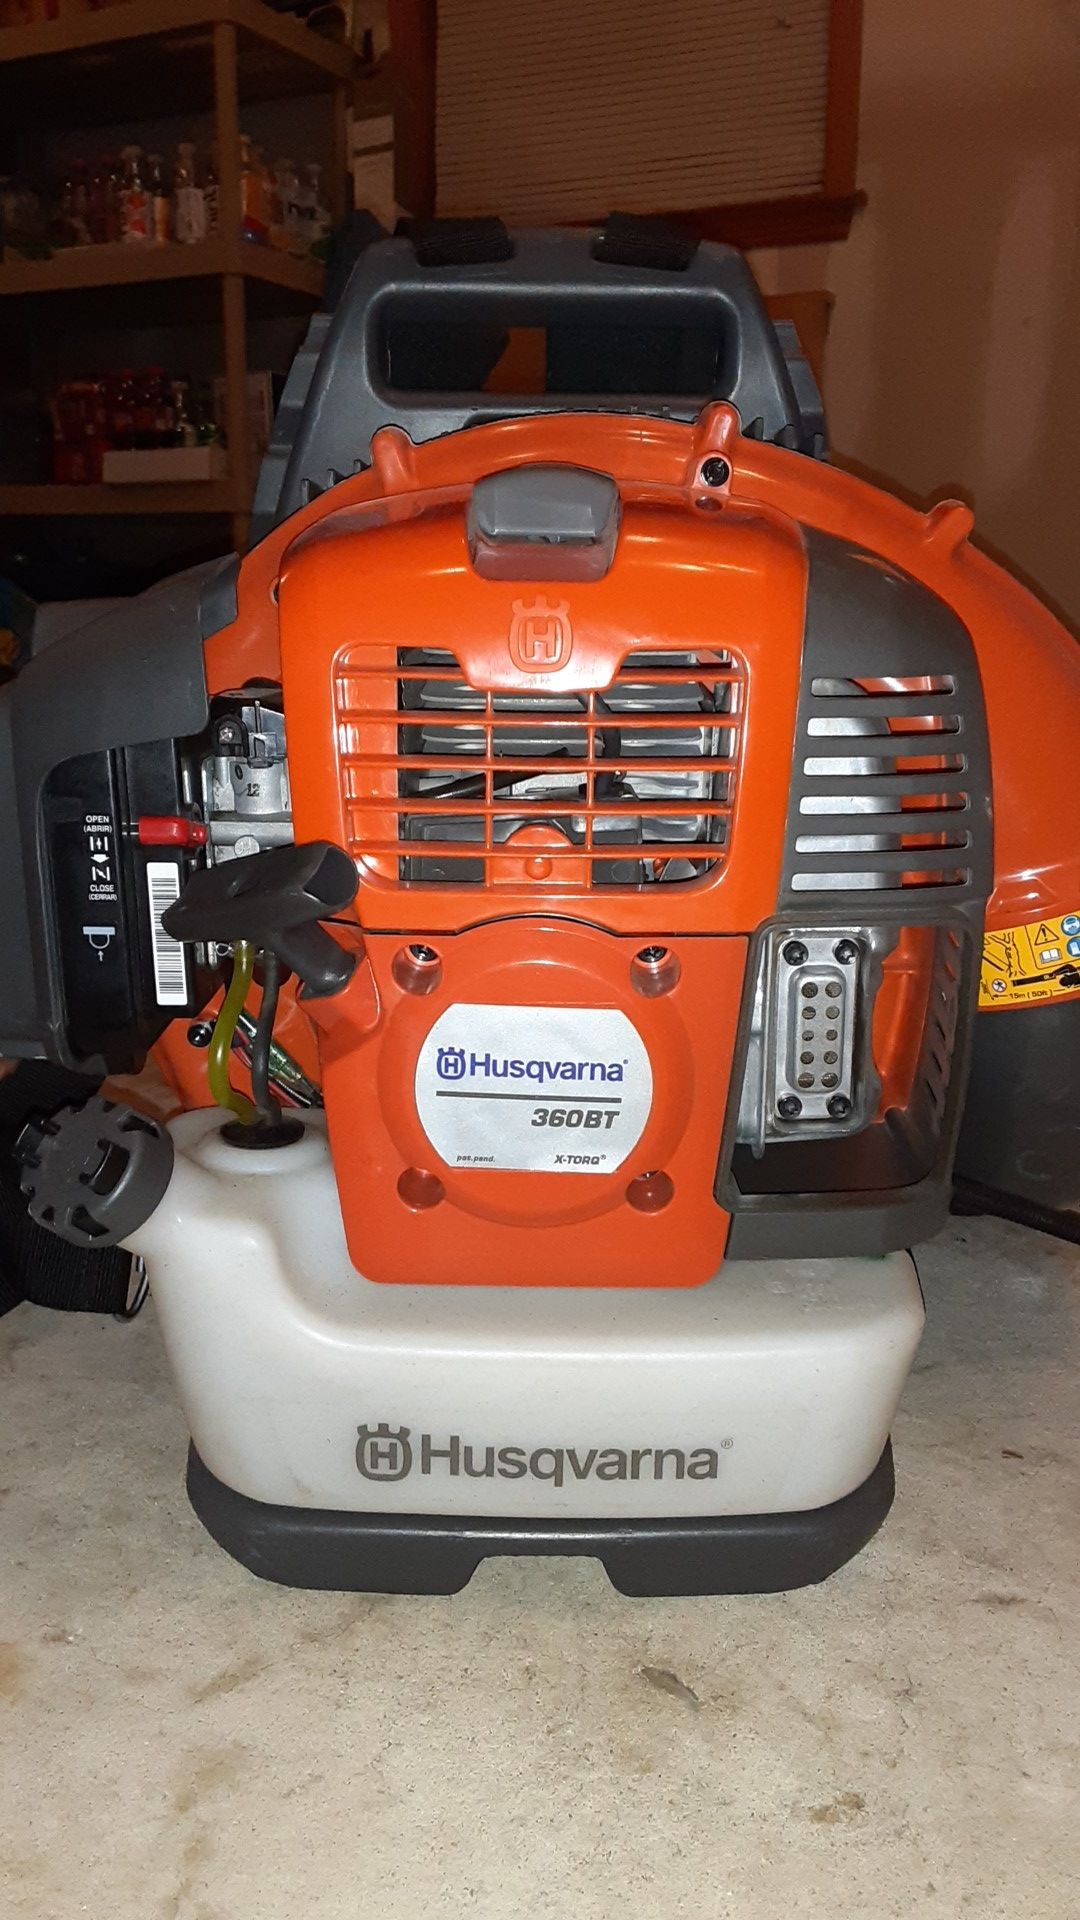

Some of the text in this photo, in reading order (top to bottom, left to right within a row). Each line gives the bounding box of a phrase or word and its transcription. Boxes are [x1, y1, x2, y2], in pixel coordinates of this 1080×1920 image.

[85, 815, 110, 823] OPEN
[83, 824, 113, 833] (ABRIR)
[89, 884, 115, 893] CLOSE
[88, 893, 118, 901] (CERRAR)
[531, 1108, 620, 1129] 360BT
